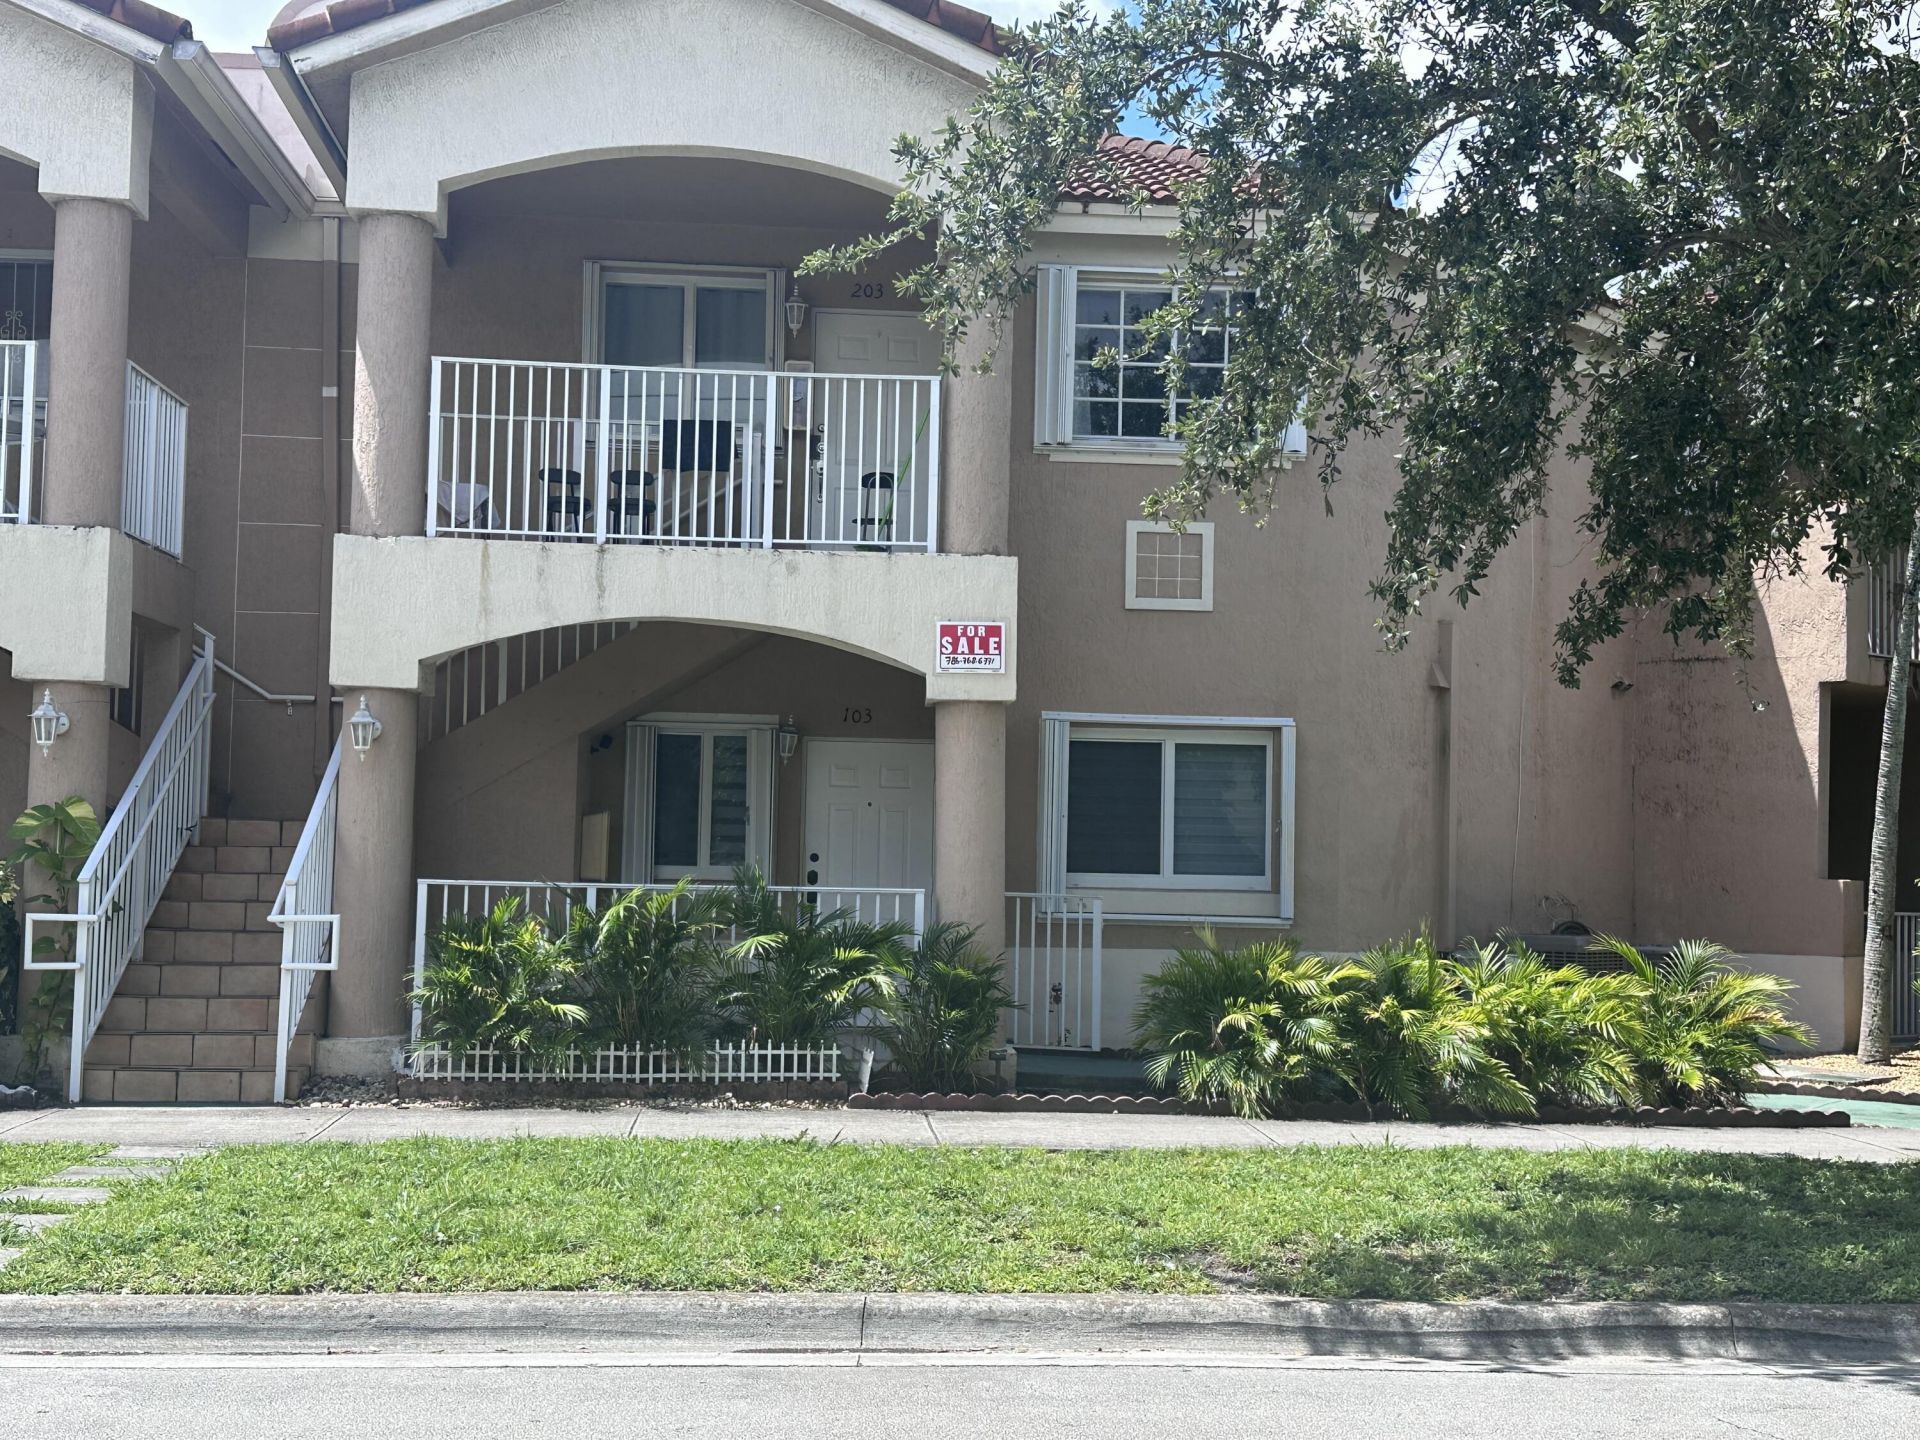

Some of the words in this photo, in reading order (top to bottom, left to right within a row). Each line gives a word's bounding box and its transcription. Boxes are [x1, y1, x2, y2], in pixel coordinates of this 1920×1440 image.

[850, 283, 883, 299] 203
[957, 625, 986, 637] FOR
[941, 636, 1000, 654] SALE
[843, 707, 872, 723] 103
